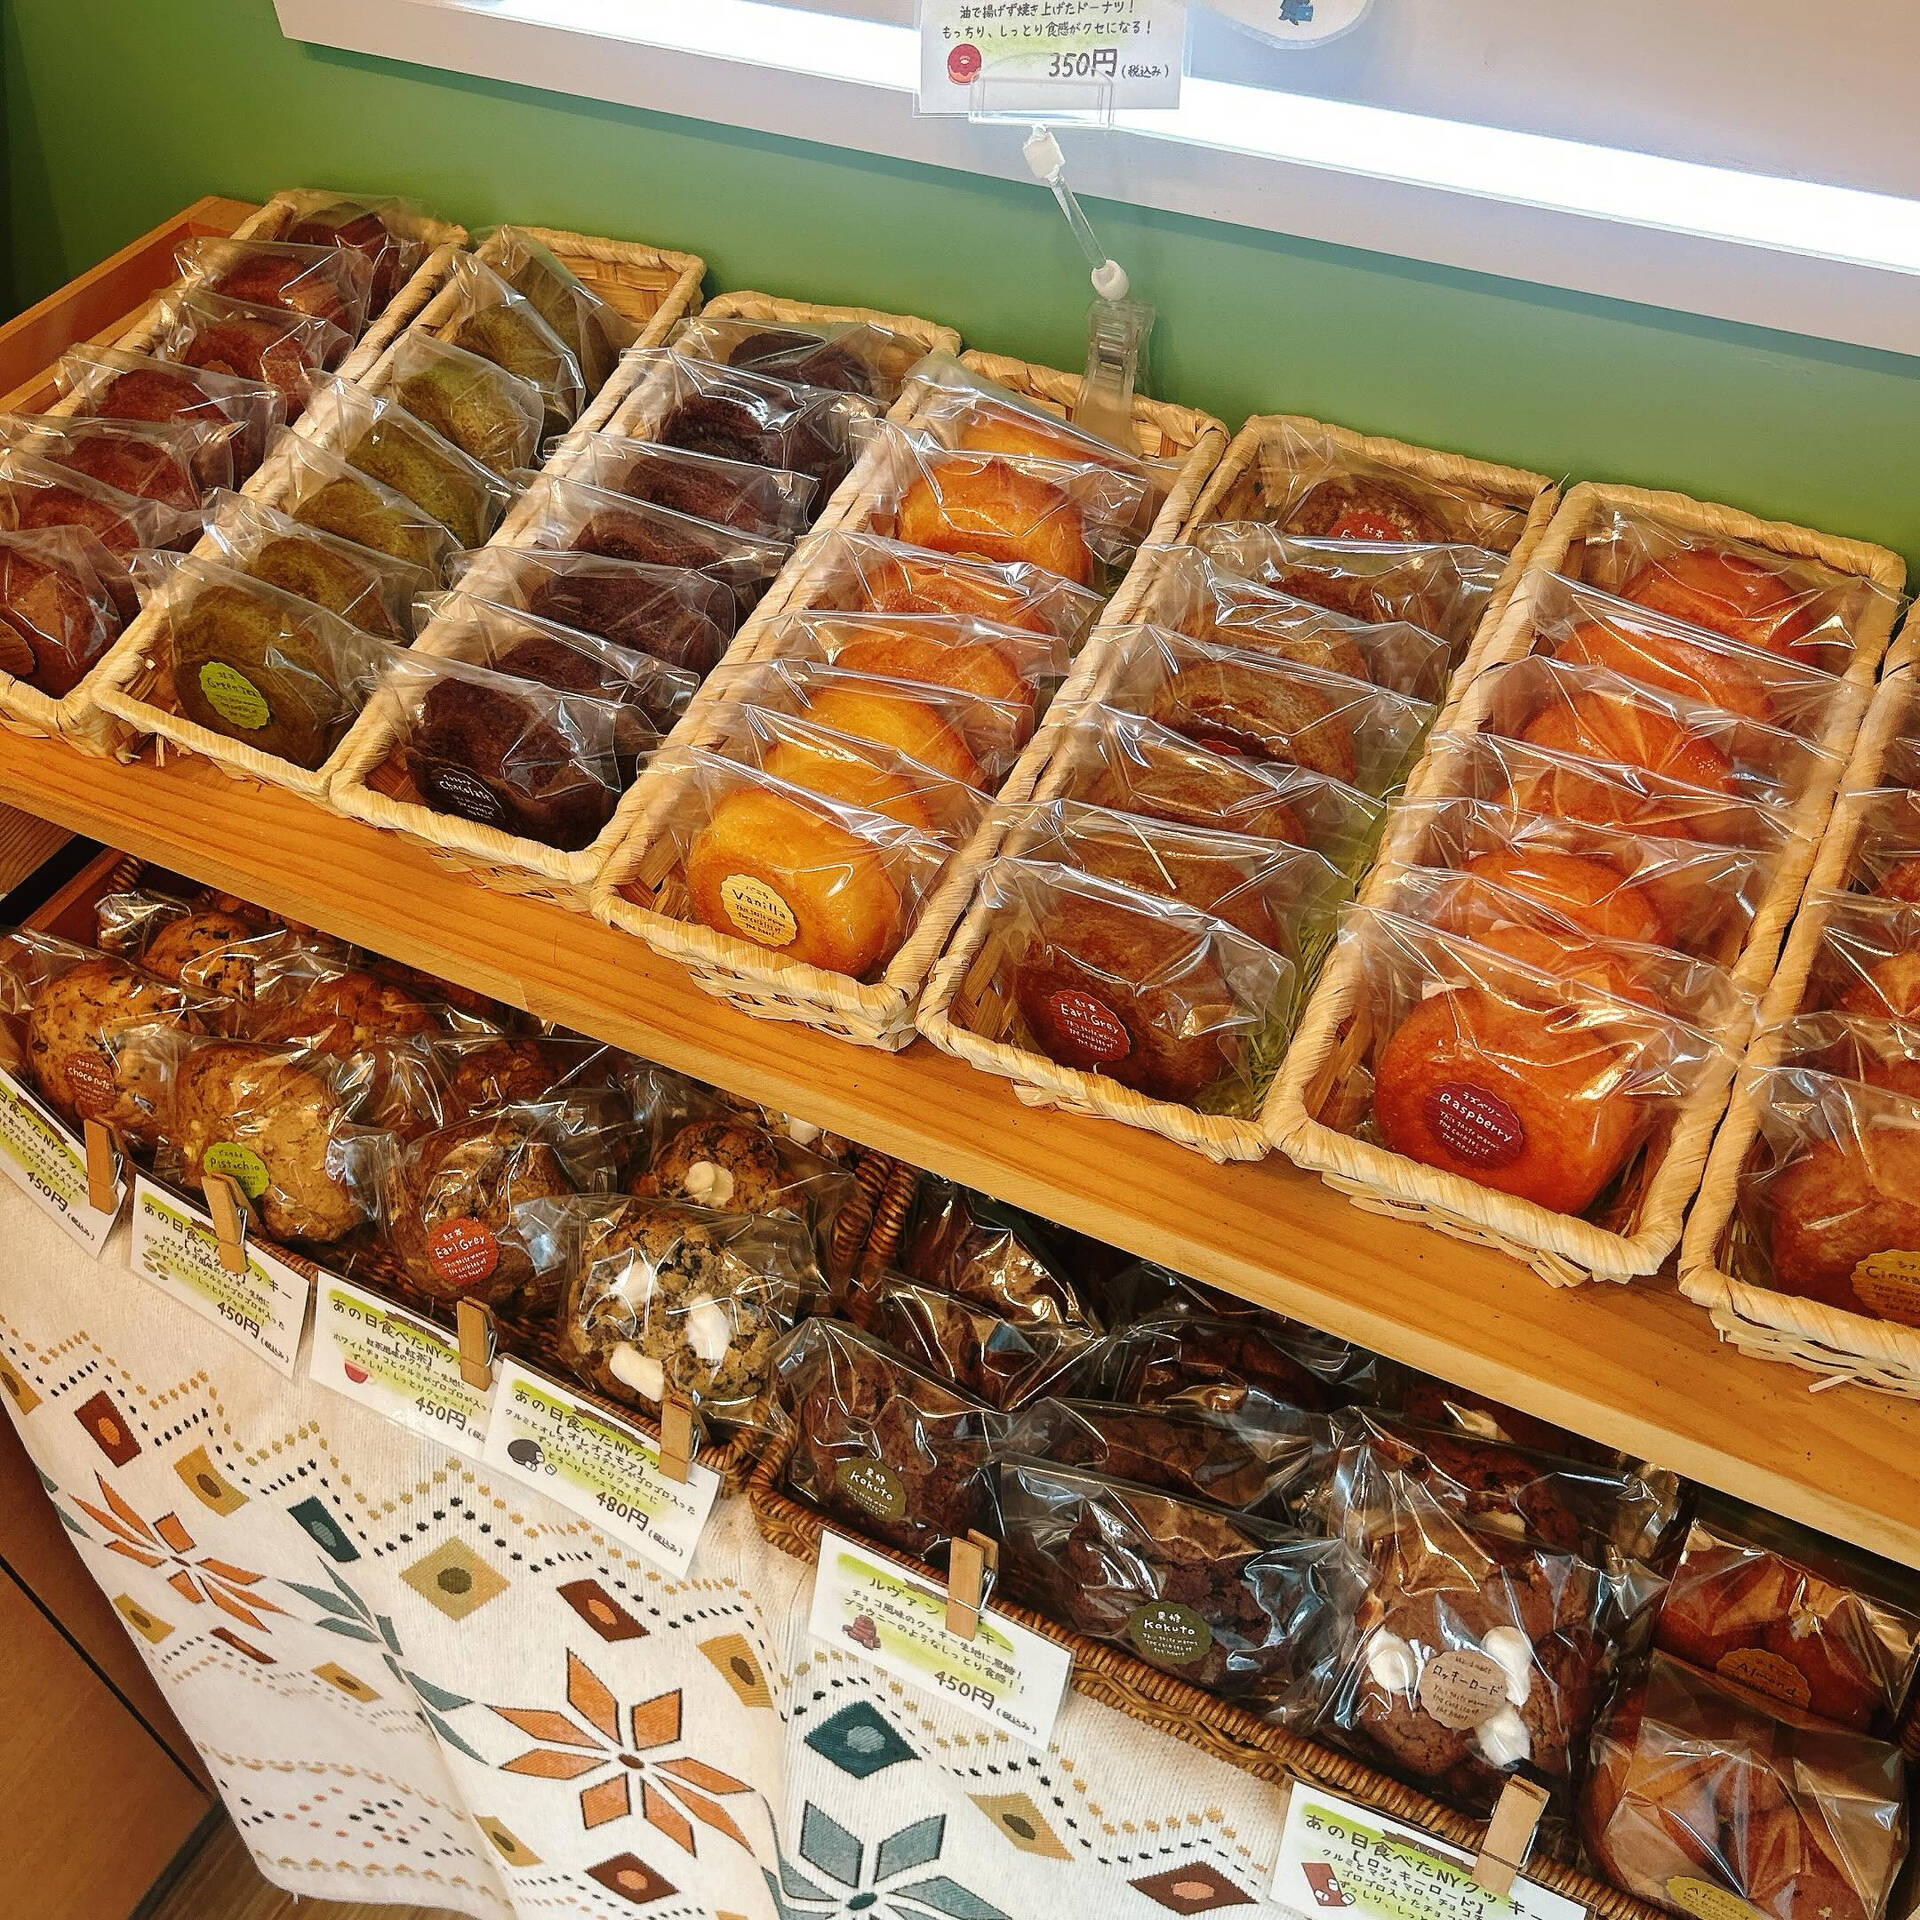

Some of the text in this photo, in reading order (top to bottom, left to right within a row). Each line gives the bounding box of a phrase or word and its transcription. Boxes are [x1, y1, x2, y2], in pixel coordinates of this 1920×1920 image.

[943, 20, 1152, 40] もっちり、しっとり食感がクセになる！
[1049, 49, 1118, 77] 350円
[732, 889, 785, 919] Vanilla
[1061, 1003, 1118, 1034] Earl Grey
[1440, 1093, 1512, 1142] Raspberry
[26, 1168, 68, 1212] 450円
[435, 1236, 485, 1259] Earl Grey
[217, 1300, 260, 1339] 450円
[415, 1396, 466, 1431] 450円
[850, 1470, 893, 1501] Kokuto
[596, 1490, 649, 1531] 480円
[1144, 1619, 1195, 1635] Kokuto
[934, 1668, 995, 1710] 450円
[1433, 1664, 1503, 1695] ロッキーロード
